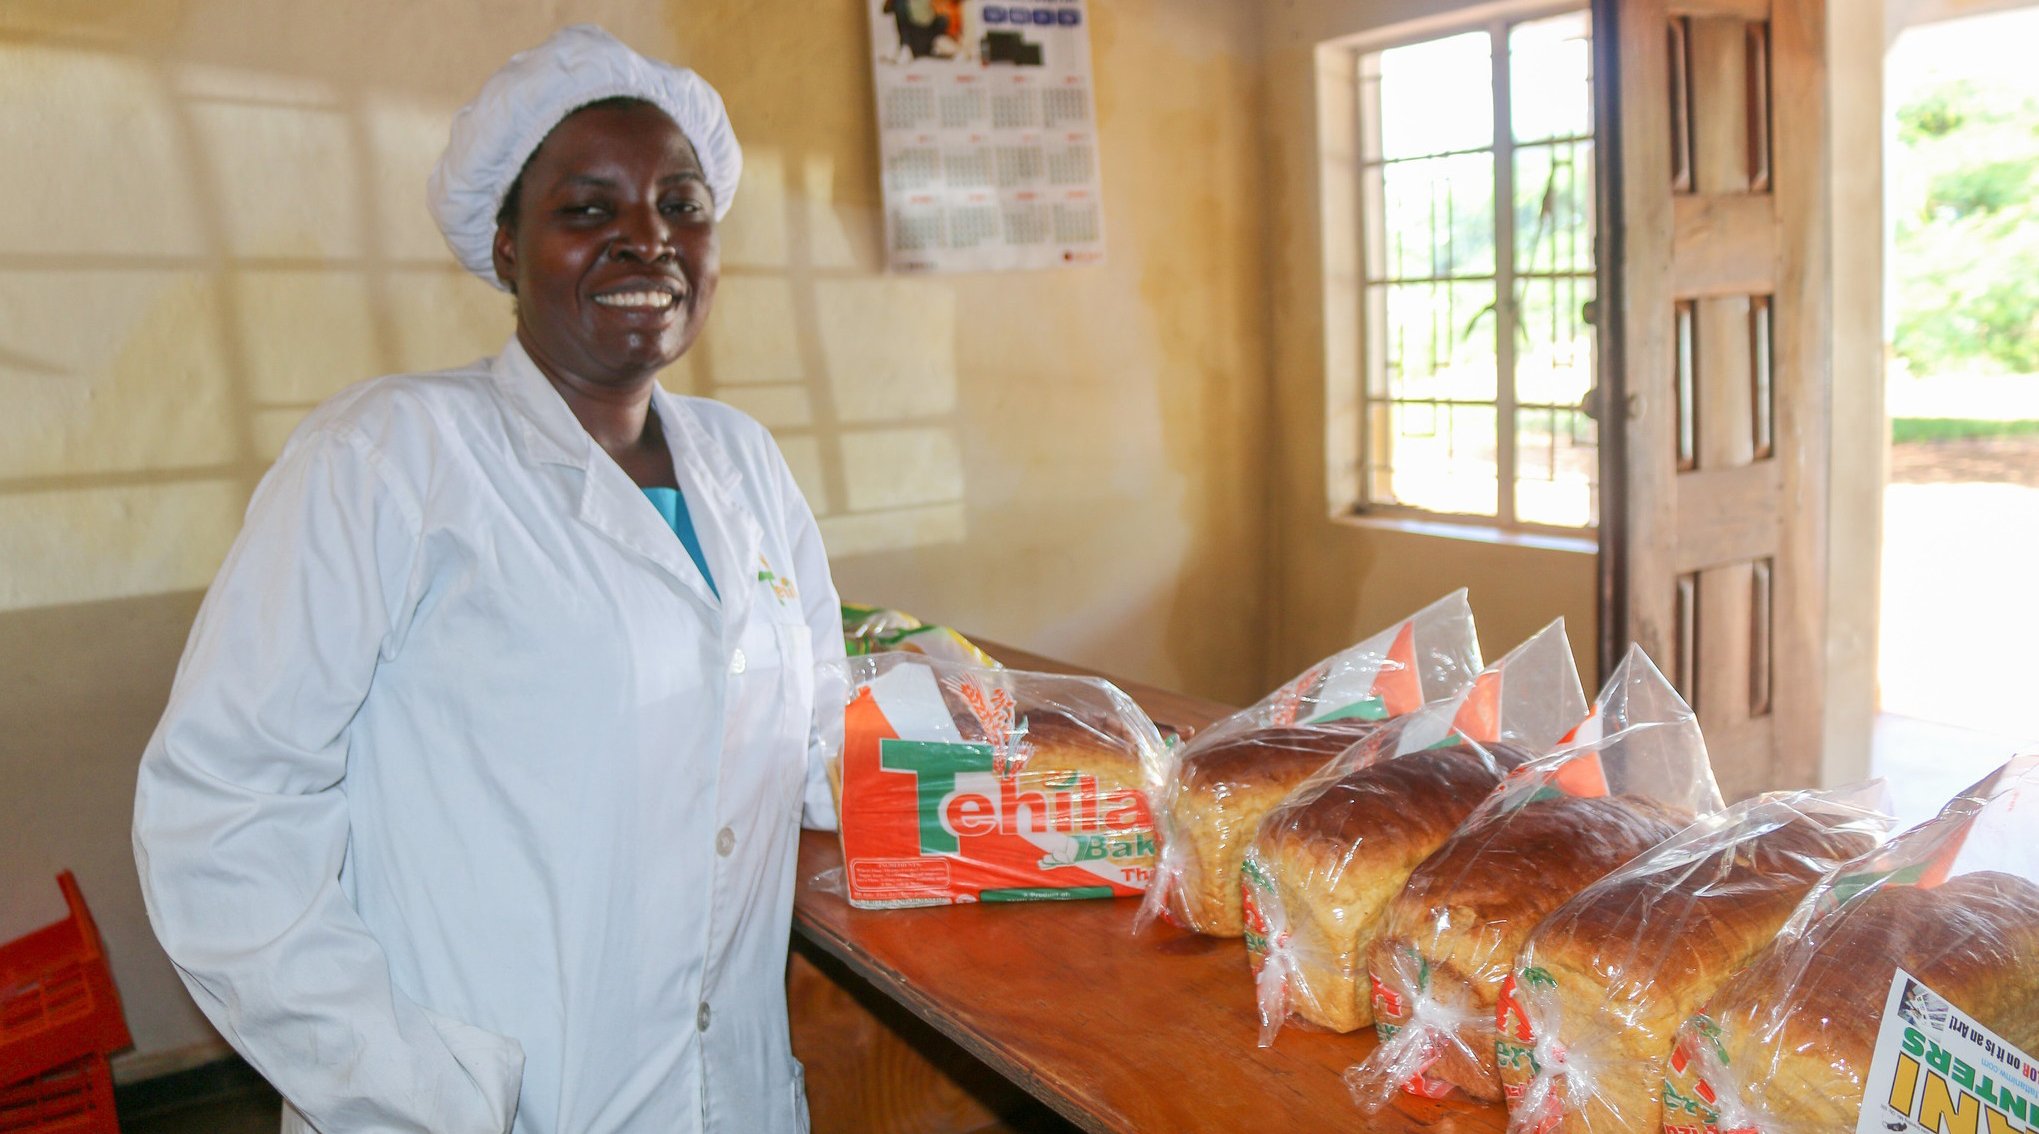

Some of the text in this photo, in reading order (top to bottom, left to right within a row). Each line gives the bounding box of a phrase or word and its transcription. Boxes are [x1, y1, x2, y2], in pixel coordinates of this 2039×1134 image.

[880, 738, 1153, 855] Tehila
[1949, 1016, 1970, 1039] Art!
[1970, 1031, 1985, 1046] an
[1996, 1046, 2006, 1061] it
[2006, 1052, 2021, 1069] on
